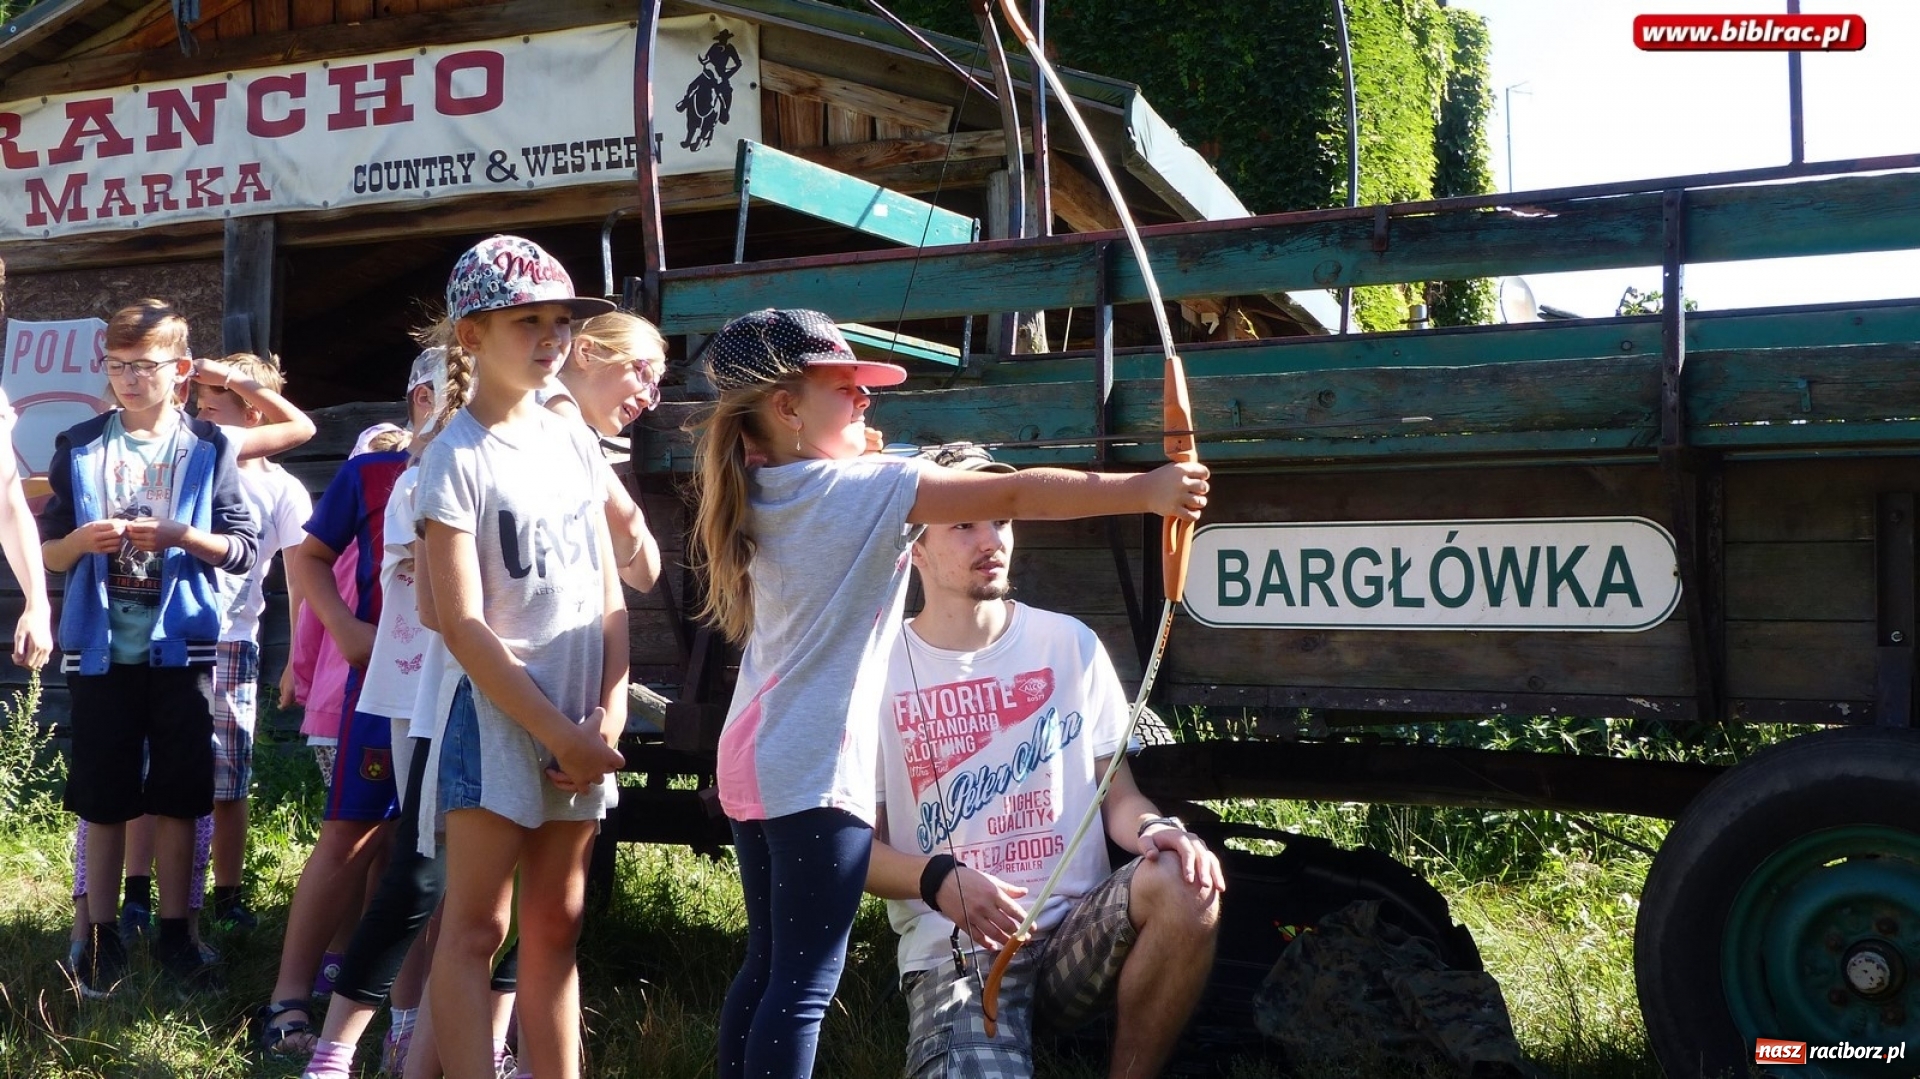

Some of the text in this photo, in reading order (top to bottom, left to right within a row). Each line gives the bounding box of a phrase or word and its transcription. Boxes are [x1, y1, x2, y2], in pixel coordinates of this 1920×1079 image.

[353, 153, 475, 194] COUNTRY
[485, 149, 520, 183] &
[25, 163, 271, 227] MARKA
[1217, 530, 1643, 609] BARGŁÓWKA
[894, 681, 1018, 726] FAVORITE
[917, 712, 1000, 741] STANDARD
[904, 735, 977, 763] CLOTHING
[987, 808, 1045, 836] QUALITY
[1005, 835, 1064, 863] GOODS
[1006, 860, 1043, 873] RETAILER
